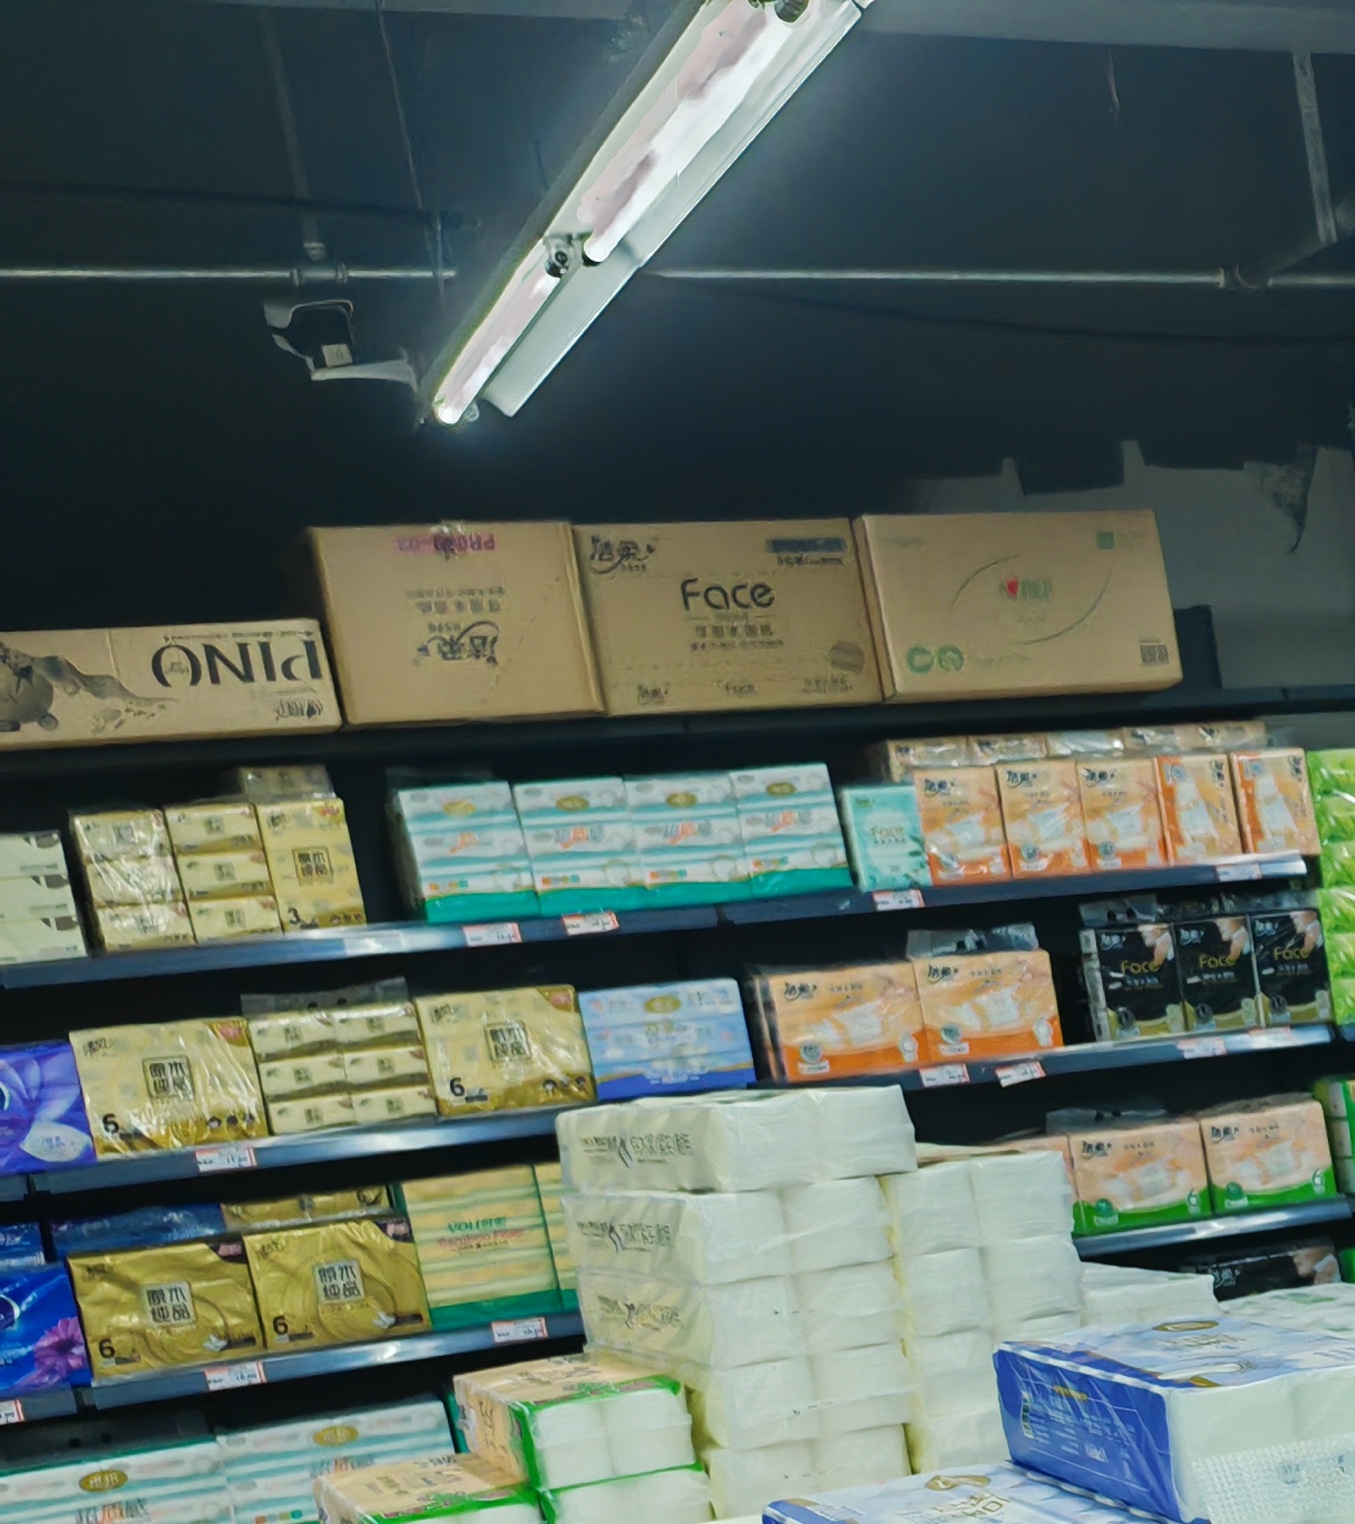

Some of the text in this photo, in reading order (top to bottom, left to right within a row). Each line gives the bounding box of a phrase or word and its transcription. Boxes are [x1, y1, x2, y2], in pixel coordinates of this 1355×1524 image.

[681, 578, 774, 611] Face
[1273, 946, 1311, 962] Face
[1119, 960, 1160, 976] Face
[449, 1077, 466, 1098] 6
[102, 1113, 120, 1134] 6
[272, 1316, 289, 1337] 6
[98, 1339, 116, 1360] 6
